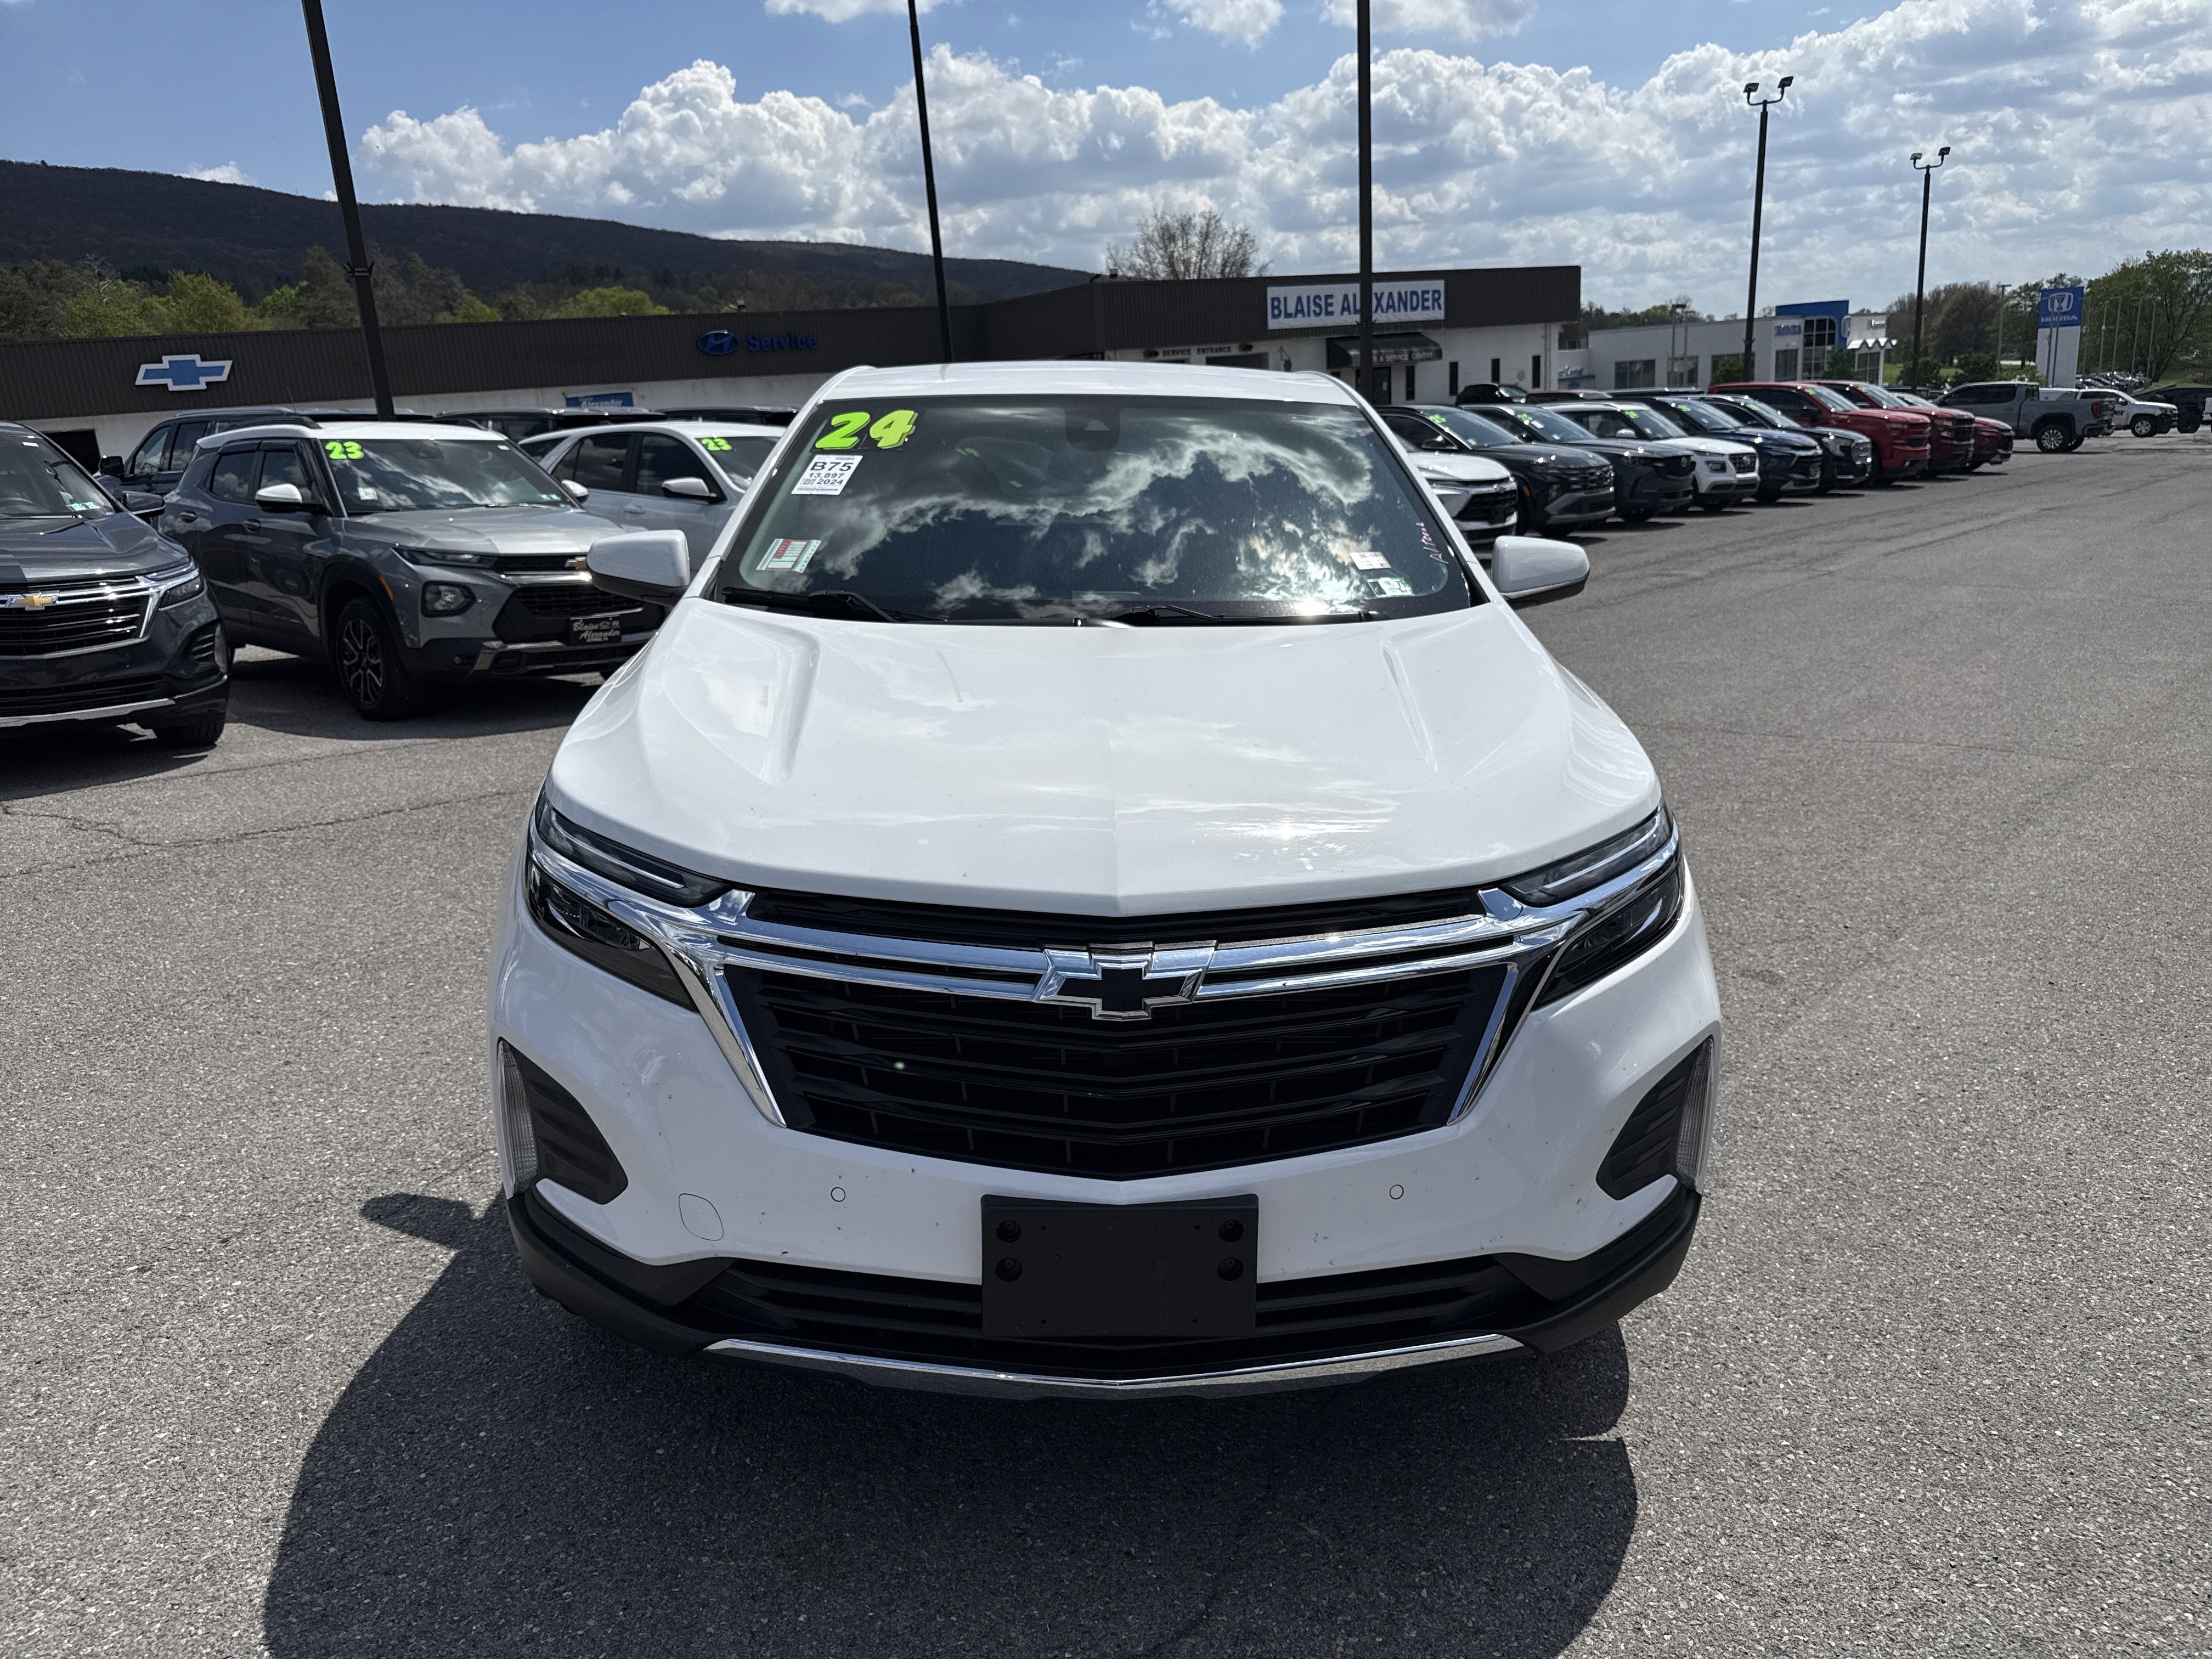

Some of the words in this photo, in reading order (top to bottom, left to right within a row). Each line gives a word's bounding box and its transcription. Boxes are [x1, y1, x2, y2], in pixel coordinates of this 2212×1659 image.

[1271, 294, 1334, 319] BLAISE
[1340, 290, 1442, 316] ALXANDER
[747, 332, 817, 352] Service
[1162, 348, 1192, 357] SERVICE
[1197, 346, 1232, 355] ENTRANCE
[815, 409, 918, 450] 24
[325, 441, 365, 459] 23
[701, 438, 733, 451] 23
[810, 461, 854, 472] B75
